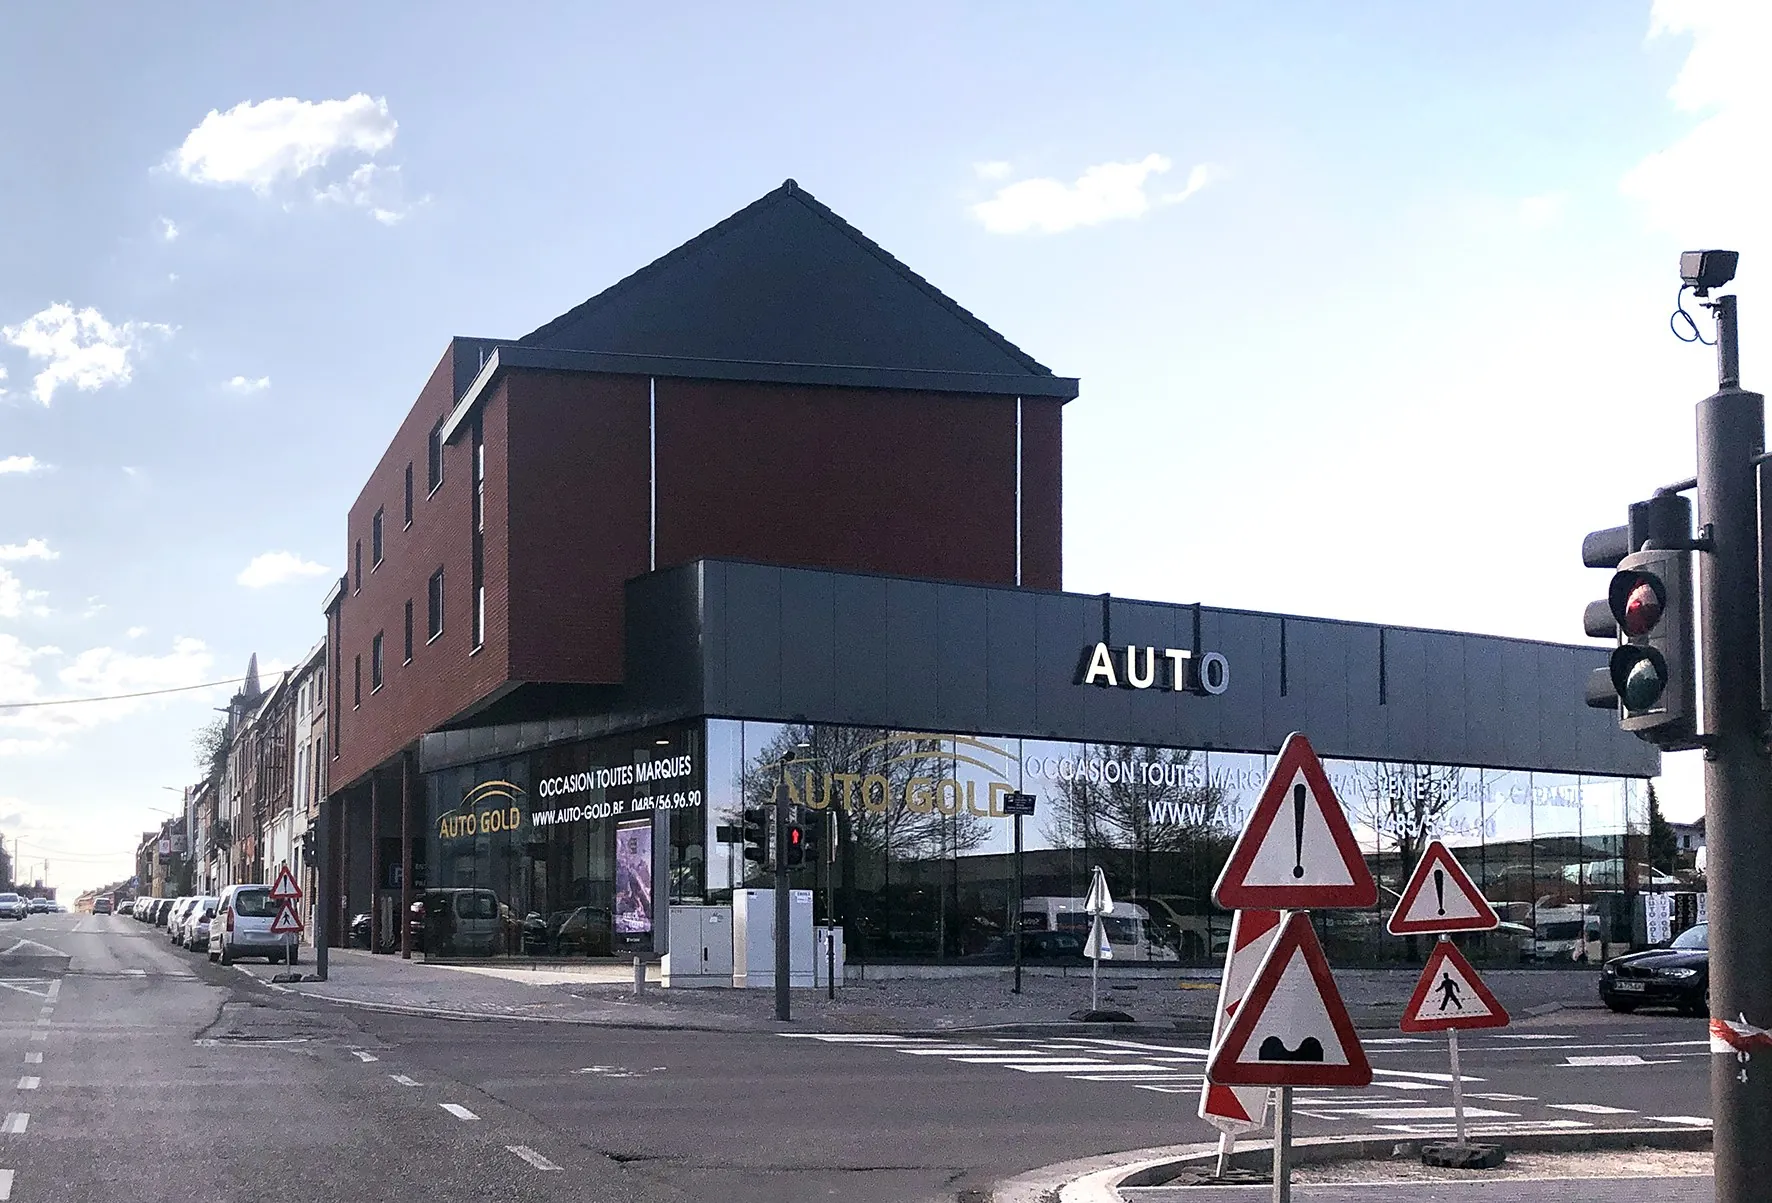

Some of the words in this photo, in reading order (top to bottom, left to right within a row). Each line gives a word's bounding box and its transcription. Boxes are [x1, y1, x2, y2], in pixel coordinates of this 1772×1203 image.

[1085, 642, 1229, 695] AUTO
[539, 772, 594, 798] OCCASION
[597, 765, 633, 789] TOUTES
[635, 755, 692, 783] MARQUES
[1025, 756, 1135, 784] OCCASION
[1140, 762, 1202, 787] TOUTES
[532, 800, 624, 827] WWW.AUTO-GOLD.BE
[631, 790, 701, 811] 0485/56.96.90
[905, 777, 1014, 818] GOLD
[439, 813, 476, 839] AUTO
[481, 807, 520, 833] GOLD
